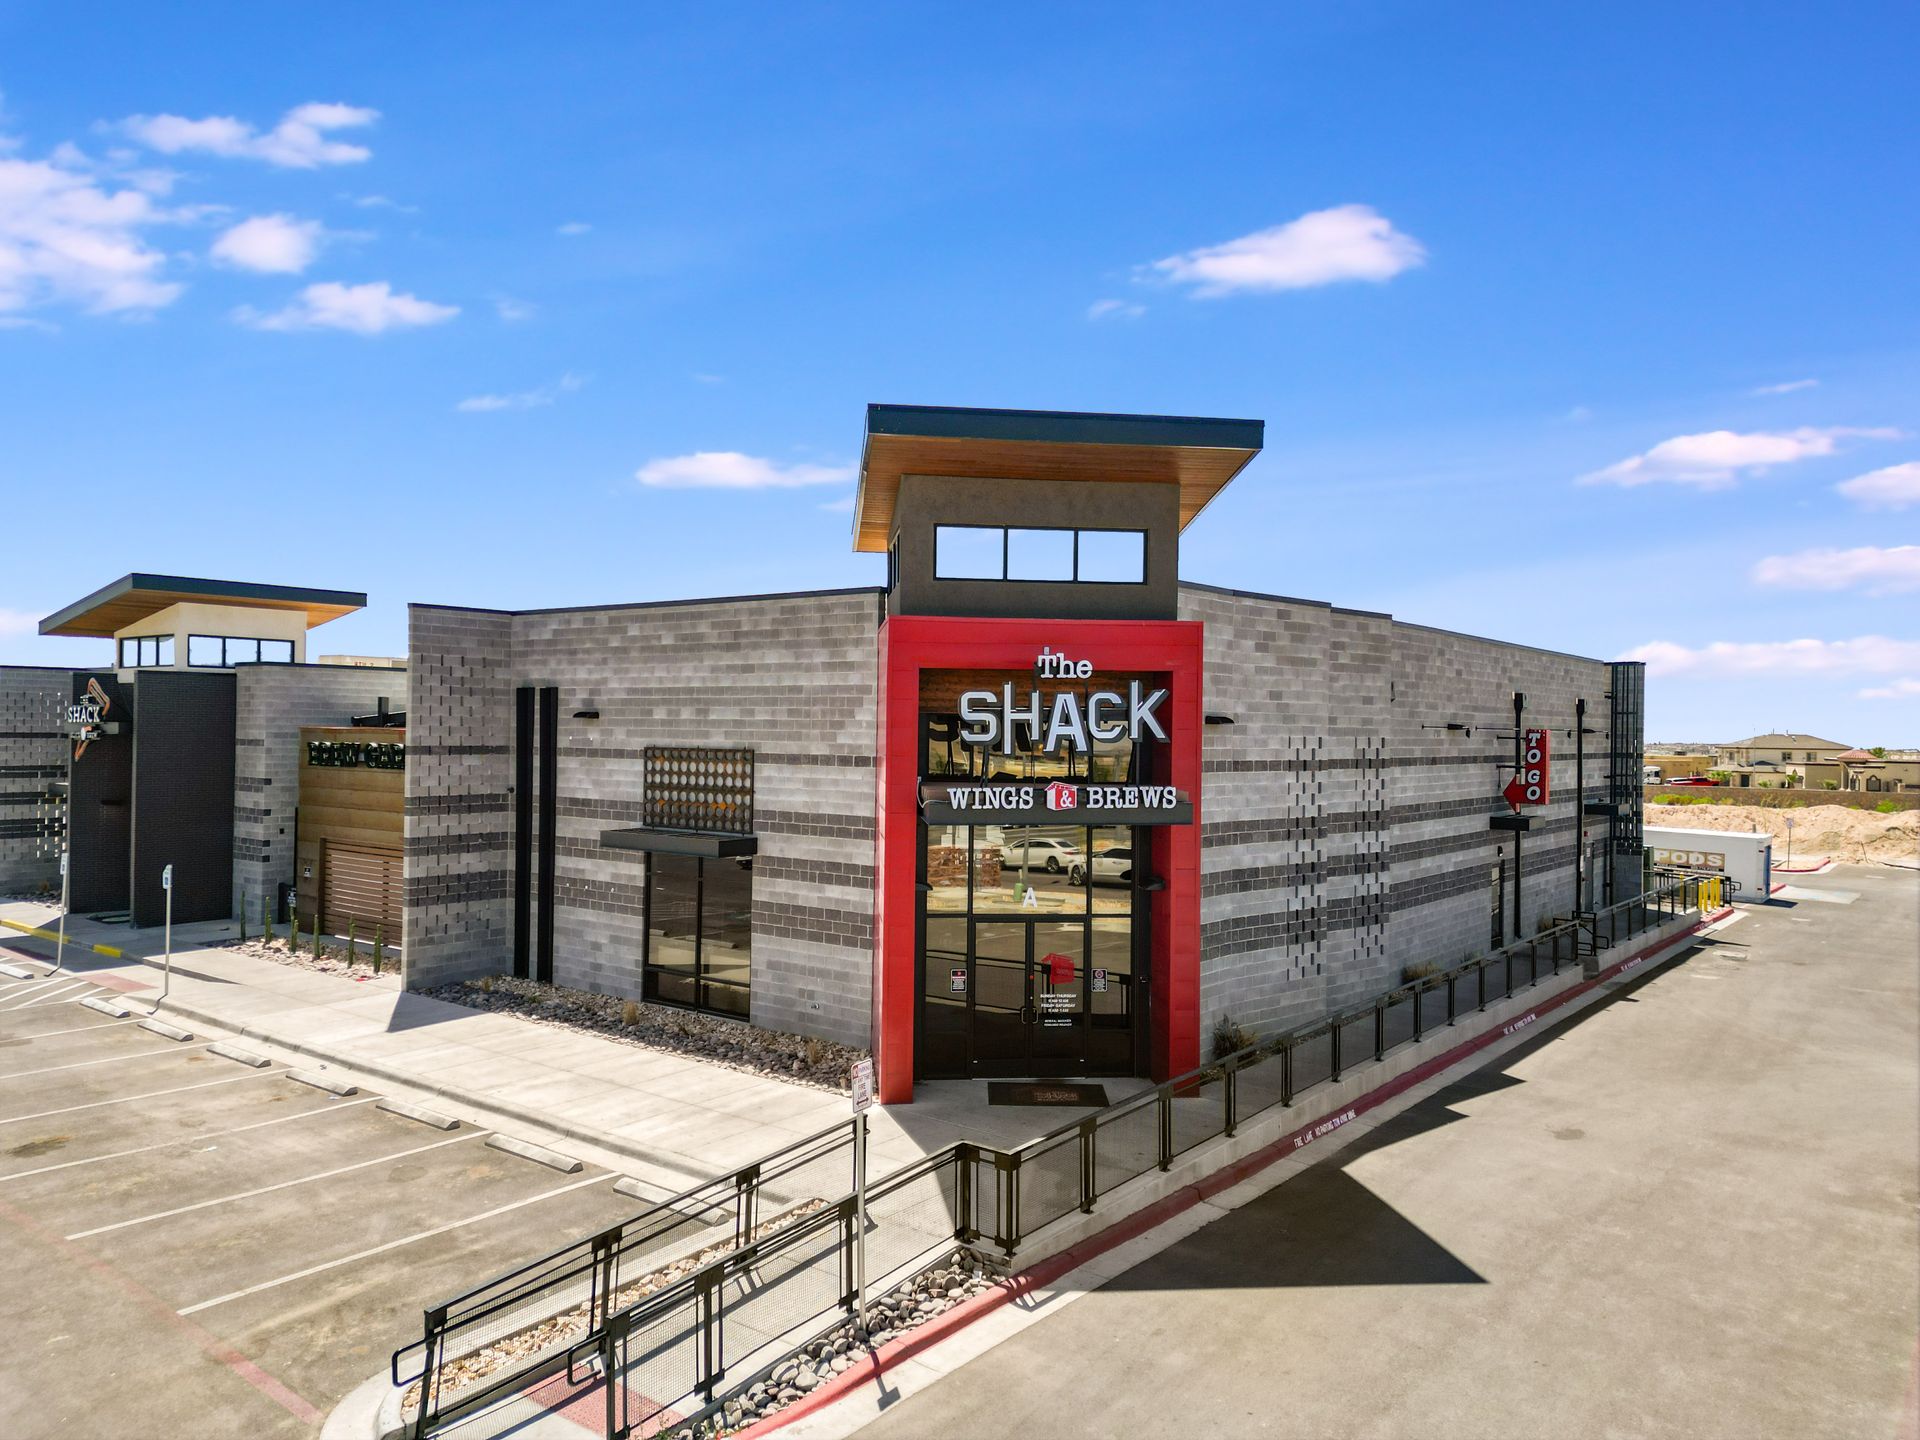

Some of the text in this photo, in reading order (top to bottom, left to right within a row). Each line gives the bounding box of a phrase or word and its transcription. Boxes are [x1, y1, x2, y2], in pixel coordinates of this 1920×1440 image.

[1037, 647, 1093, 679] The
[67, 705, 100, 722] SHACK
[960, 680, 1167, 755] SHACK
[946, 786, 1034, 810] WINGS
[1086, 786, 1177, 809] BREWS
[1653, 849, 1722, 867] PODS
[1022, 886, 1038, 908] A
[857, 1090, 867, 1100] LANE
